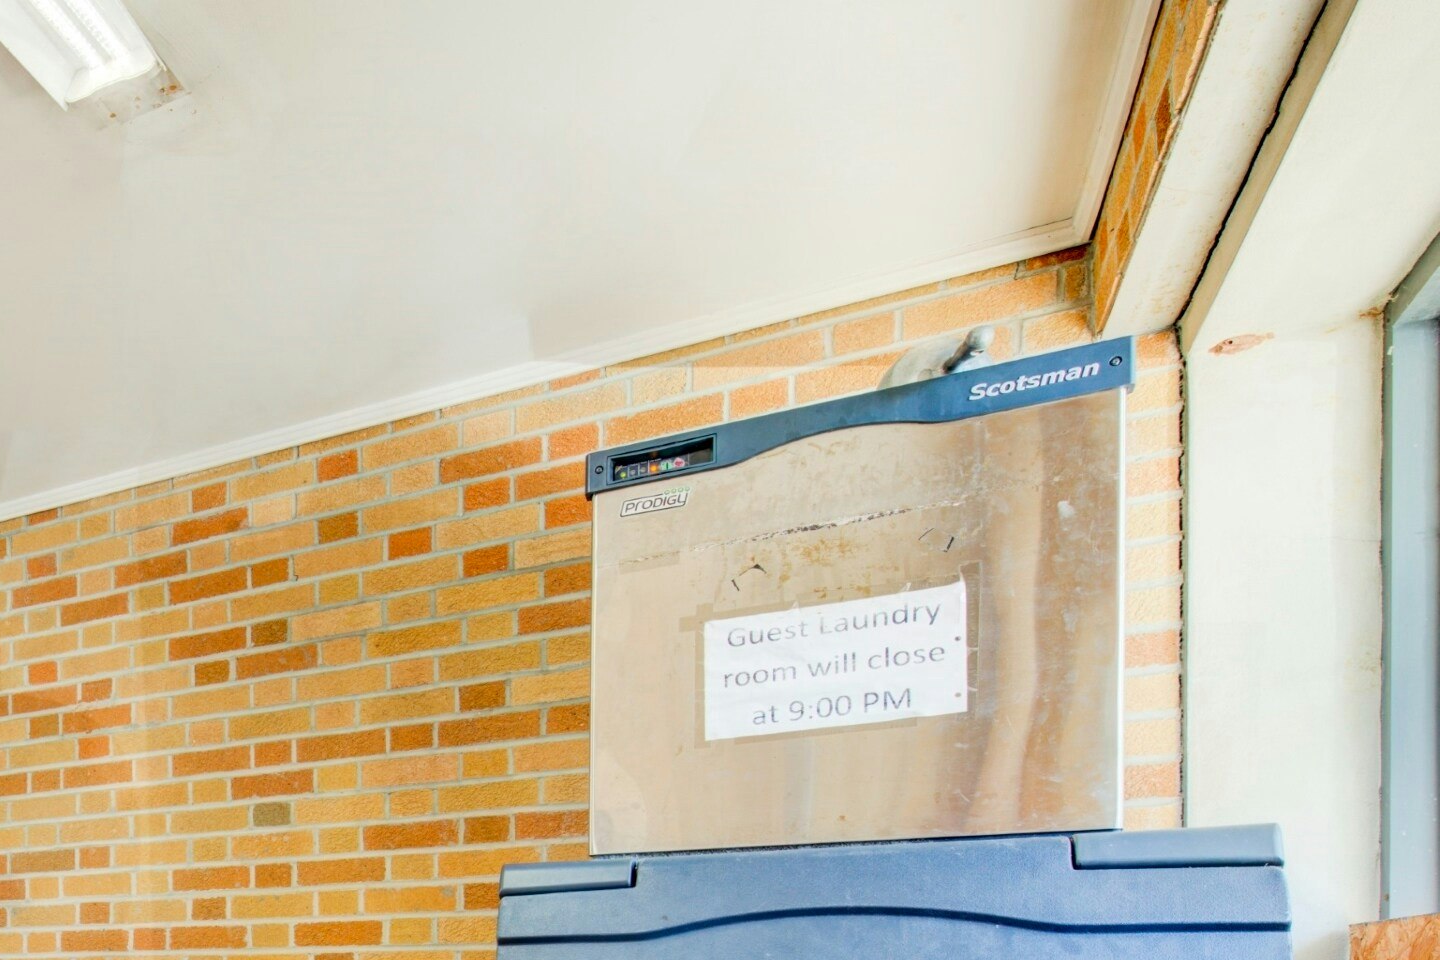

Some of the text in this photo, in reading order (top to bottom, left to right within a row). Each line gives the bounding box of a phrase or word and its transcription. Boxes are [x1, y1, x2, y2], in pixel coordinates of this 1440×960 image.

[968, 361, 1101, 401] Scotsman
[727, 603, 942, 648] Guest Laundry
[723, 646, 946, 689] room will close
[752, 687, 913, 726] at 9:00 PM
